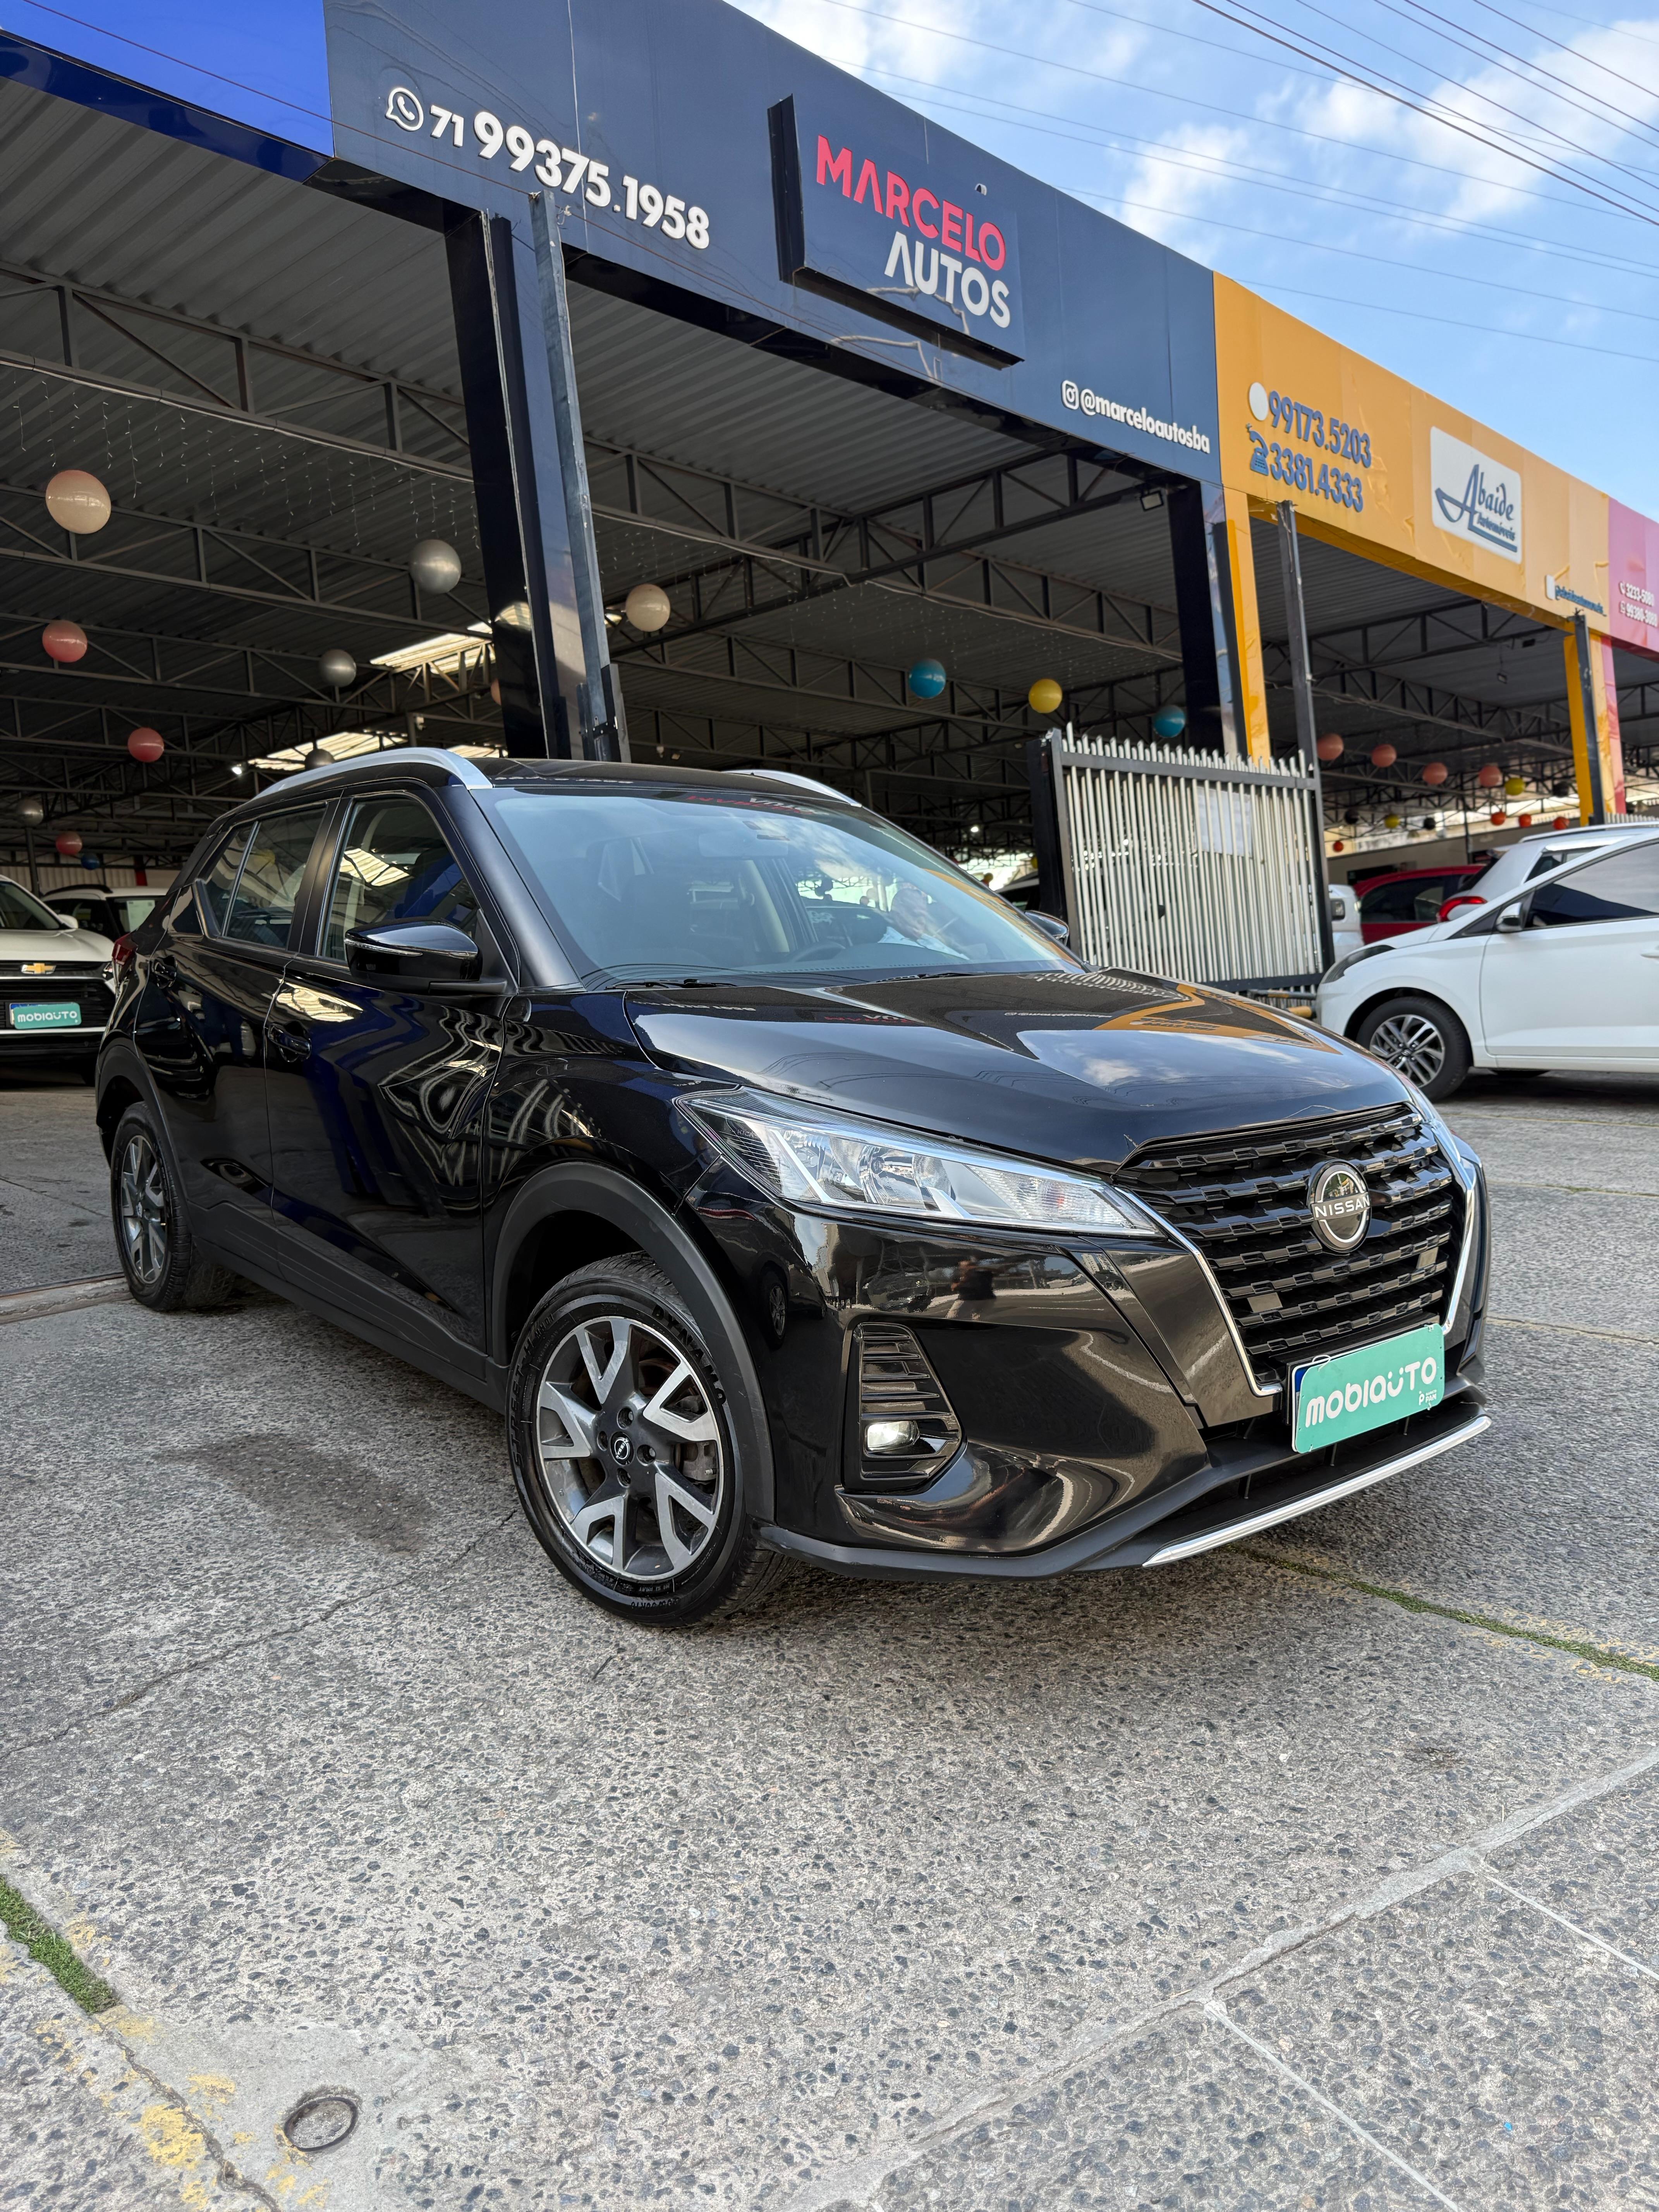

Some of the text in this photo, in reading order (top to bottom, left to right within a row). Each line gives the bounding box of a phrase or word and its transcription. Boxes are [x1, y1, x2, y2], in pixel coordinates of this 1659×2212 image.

[430, 105, 710, 249] 71 99375.1958
[816, 135, 1006, 271] MARCELO
[884, 232, 1010, 328] AUTOS
[1080, 388, 1210, 454] @marceloautosba
[1269, 390, 1371, 468] 99173.5203
[1270, 442, 1363, 512] 3381.4333
[1435, 464, 1515, 529] Abaide
[1315, 1192, 1370, 1220] NISSAN
